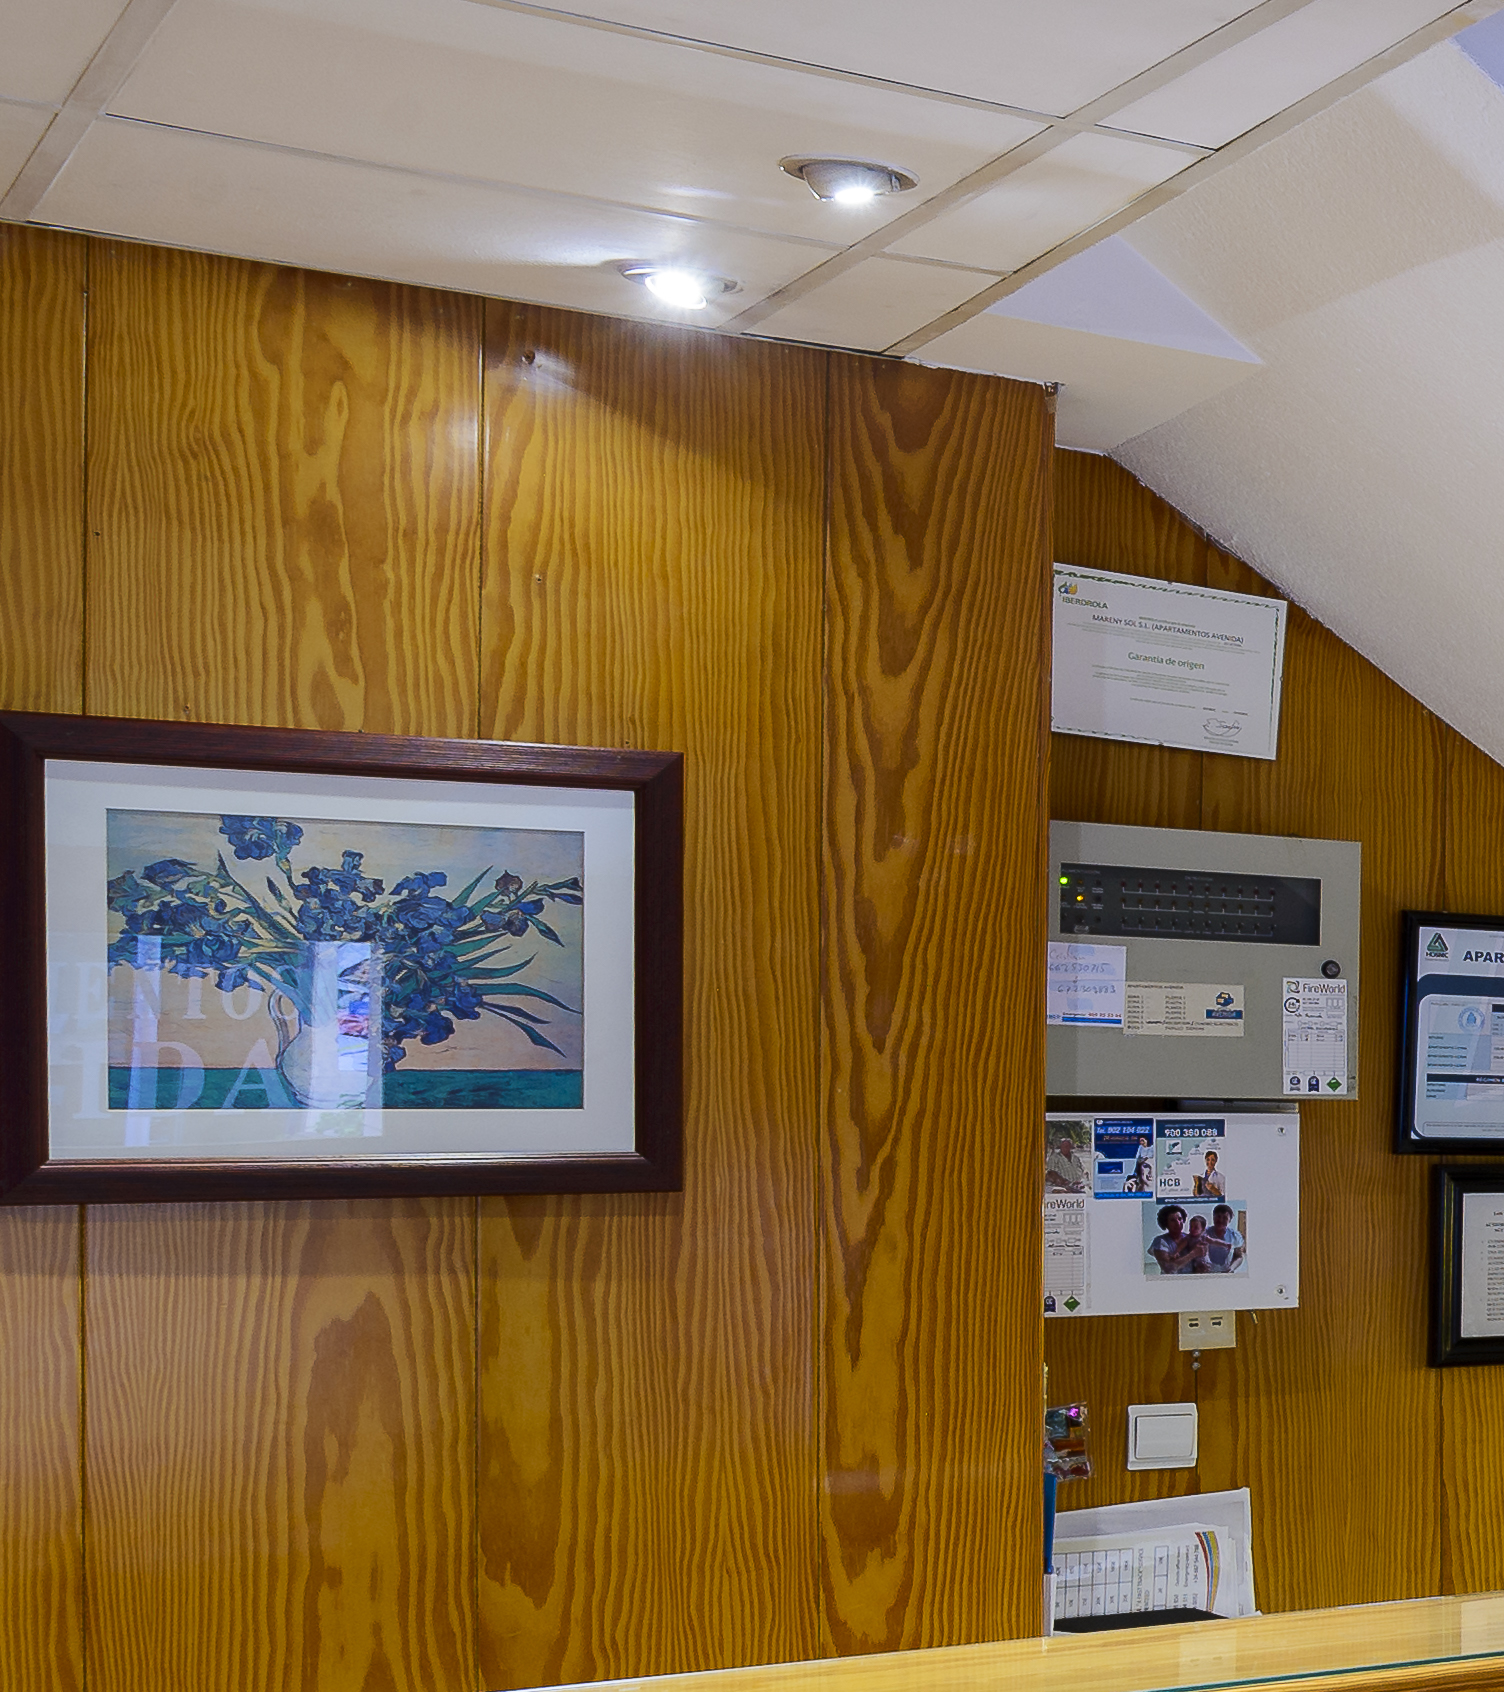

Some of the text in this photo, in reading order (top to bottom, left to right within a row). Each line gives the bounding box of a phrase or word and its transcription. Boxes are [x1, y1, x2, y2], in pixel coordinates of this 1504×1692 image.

[1062, 596, 1108, 610] IBERDROLA
[1092, 614, 1122, 625] MARENY
[1124, 618, 1137, 628] SOL
[1152, 623, 1210, 639] (APARTAMENTOS
[1165, 656, 1176, 666] de
[1178, 660, 1205, 670] origen
[1302, 983, 1346, 994] FireWorld
[1160, 1178, 1181, 1188] HCB
